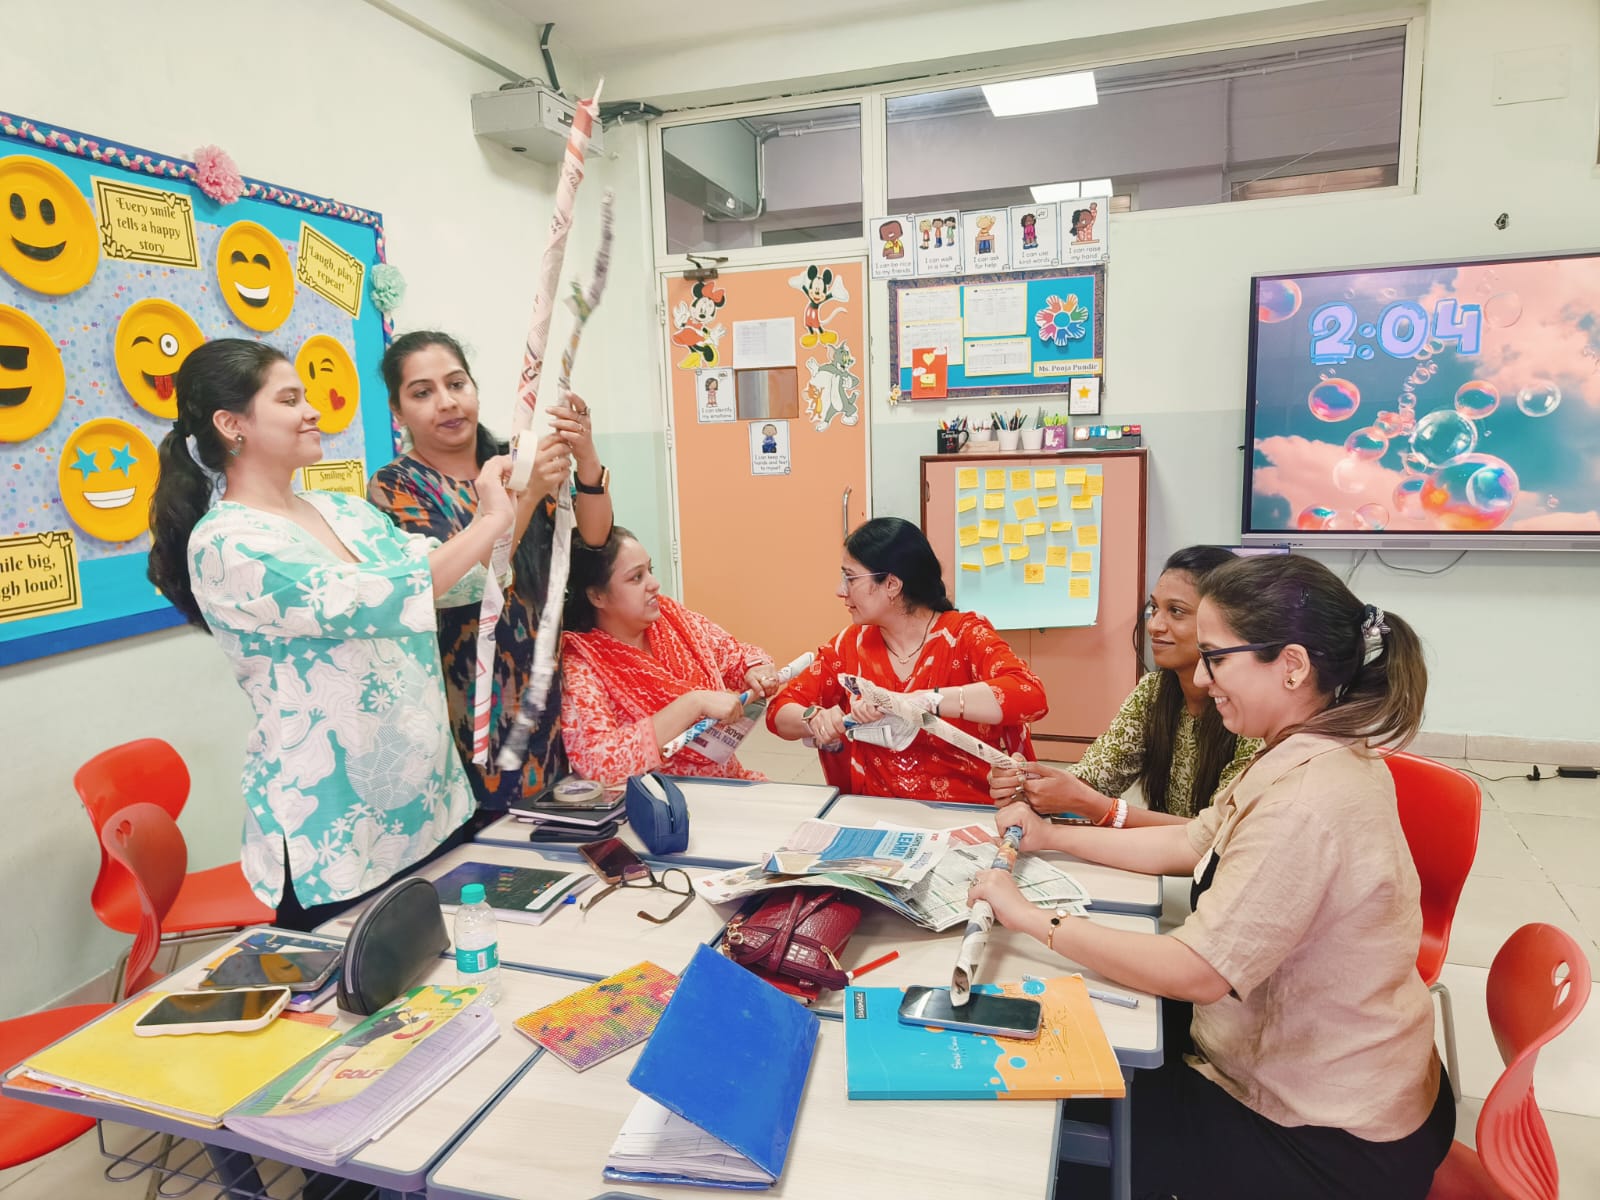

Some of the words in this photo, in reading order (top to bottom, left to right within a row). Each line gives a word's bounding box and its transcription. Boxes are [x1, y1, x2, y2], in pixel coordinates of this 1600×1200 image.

[116, 197, 148, 217] Every
[150, 205, 176, 219] smile
[117, 216, 139, 231] tells
[141, 223, 148, 232] a
[150, 220, 181, 239] happy
[139, 240, 165, 254] story
[309, 245, 336, 272] Laugh,
[337, 267, 355, 286] play,
[317, 270, 345, 293] repeat!
[1308, 297, 1483, 363] 2:04
[1051, 364, 1072, 372] Pooja
[27, 554, 56, 572] big,
[24, 573, 63, 594] loud!
[334, 1068, 385, 1080] GOLF
